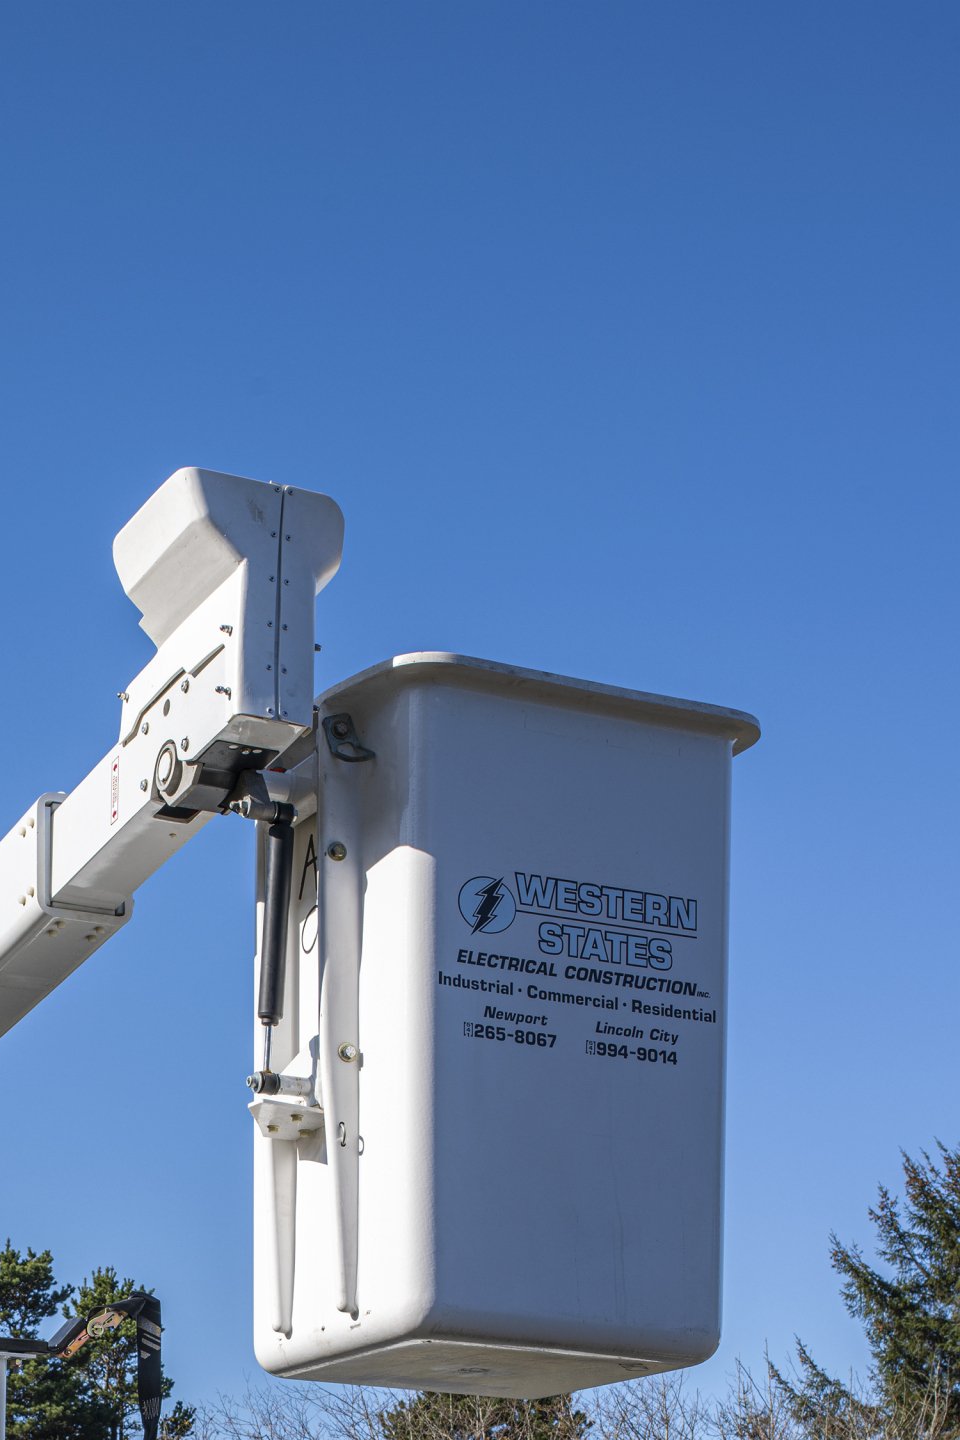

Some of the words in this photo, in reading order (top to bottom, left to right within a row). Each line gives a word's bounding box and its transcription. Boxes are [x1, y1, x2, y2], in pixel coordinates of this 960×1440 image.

[514, 871, 698, 932] WESTERN
[538, 921, 673, 972] STATES
[456, 948, 558, 978] ELECTRICAL
[564, 965, 698, 997] CONSTRUCTION
[696, 991, 712, 999] INC.
[438, 970, 514, 996] Industrial
[527, 984, 619, 1011] Commercial
[631, 998, 717, 1024] Residential
[483, 1004, 548, 1026] Newport
[474, 1023, 558, 1048] 265-8067
[595, 1020, 644, 1040] Lincoln
[649, 1027, 679, 1046] City
[596, 1041, 678, 1066] 994-9014
